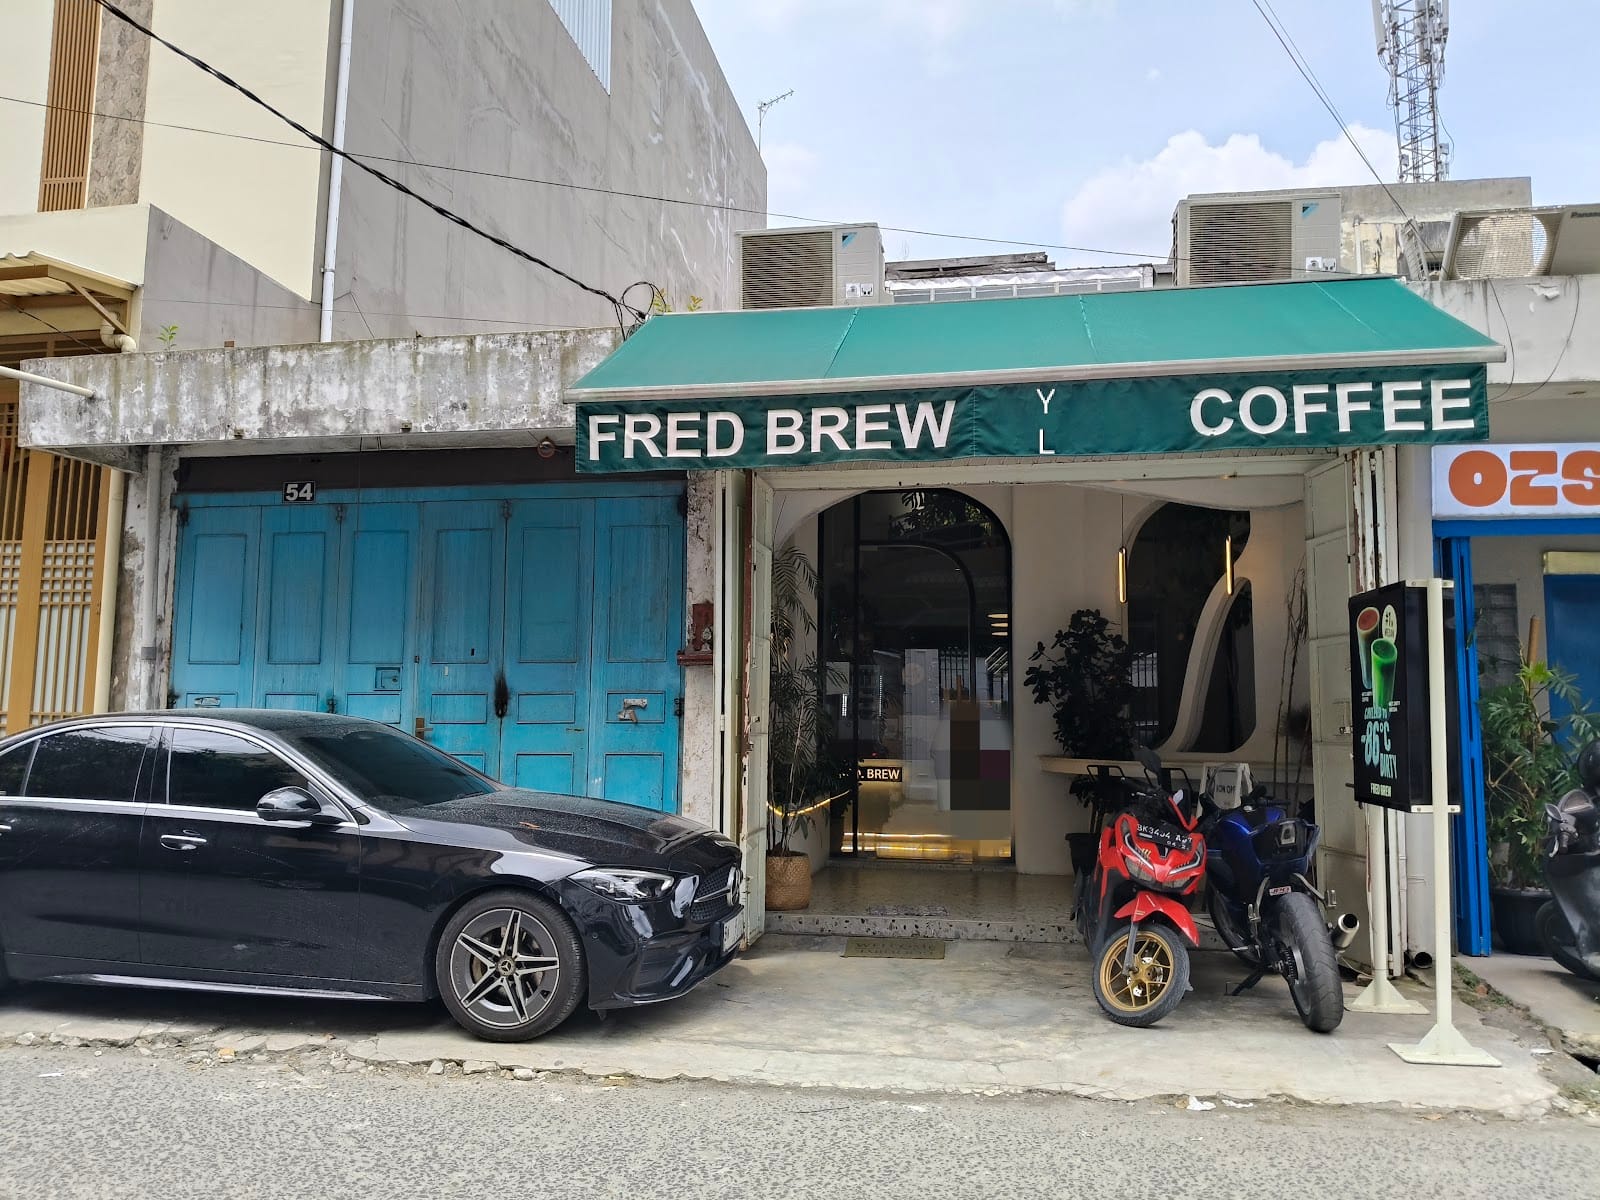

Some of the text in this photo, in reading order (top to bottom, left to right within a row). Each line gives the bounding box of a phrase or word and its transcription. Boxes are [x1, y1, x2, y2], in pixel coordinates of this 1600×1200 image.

[1036, 388, 1056, 414] Y
[1189, 378, 1475, 437] COFFEE
[587, 400, 957, 461] FRED BREW
[1039, 429, 1056, 454] L
[285, 482, 313, 501] 54
[1448, 450, 1600, 508] OZS
[866, 768, 900, 779] BREW
